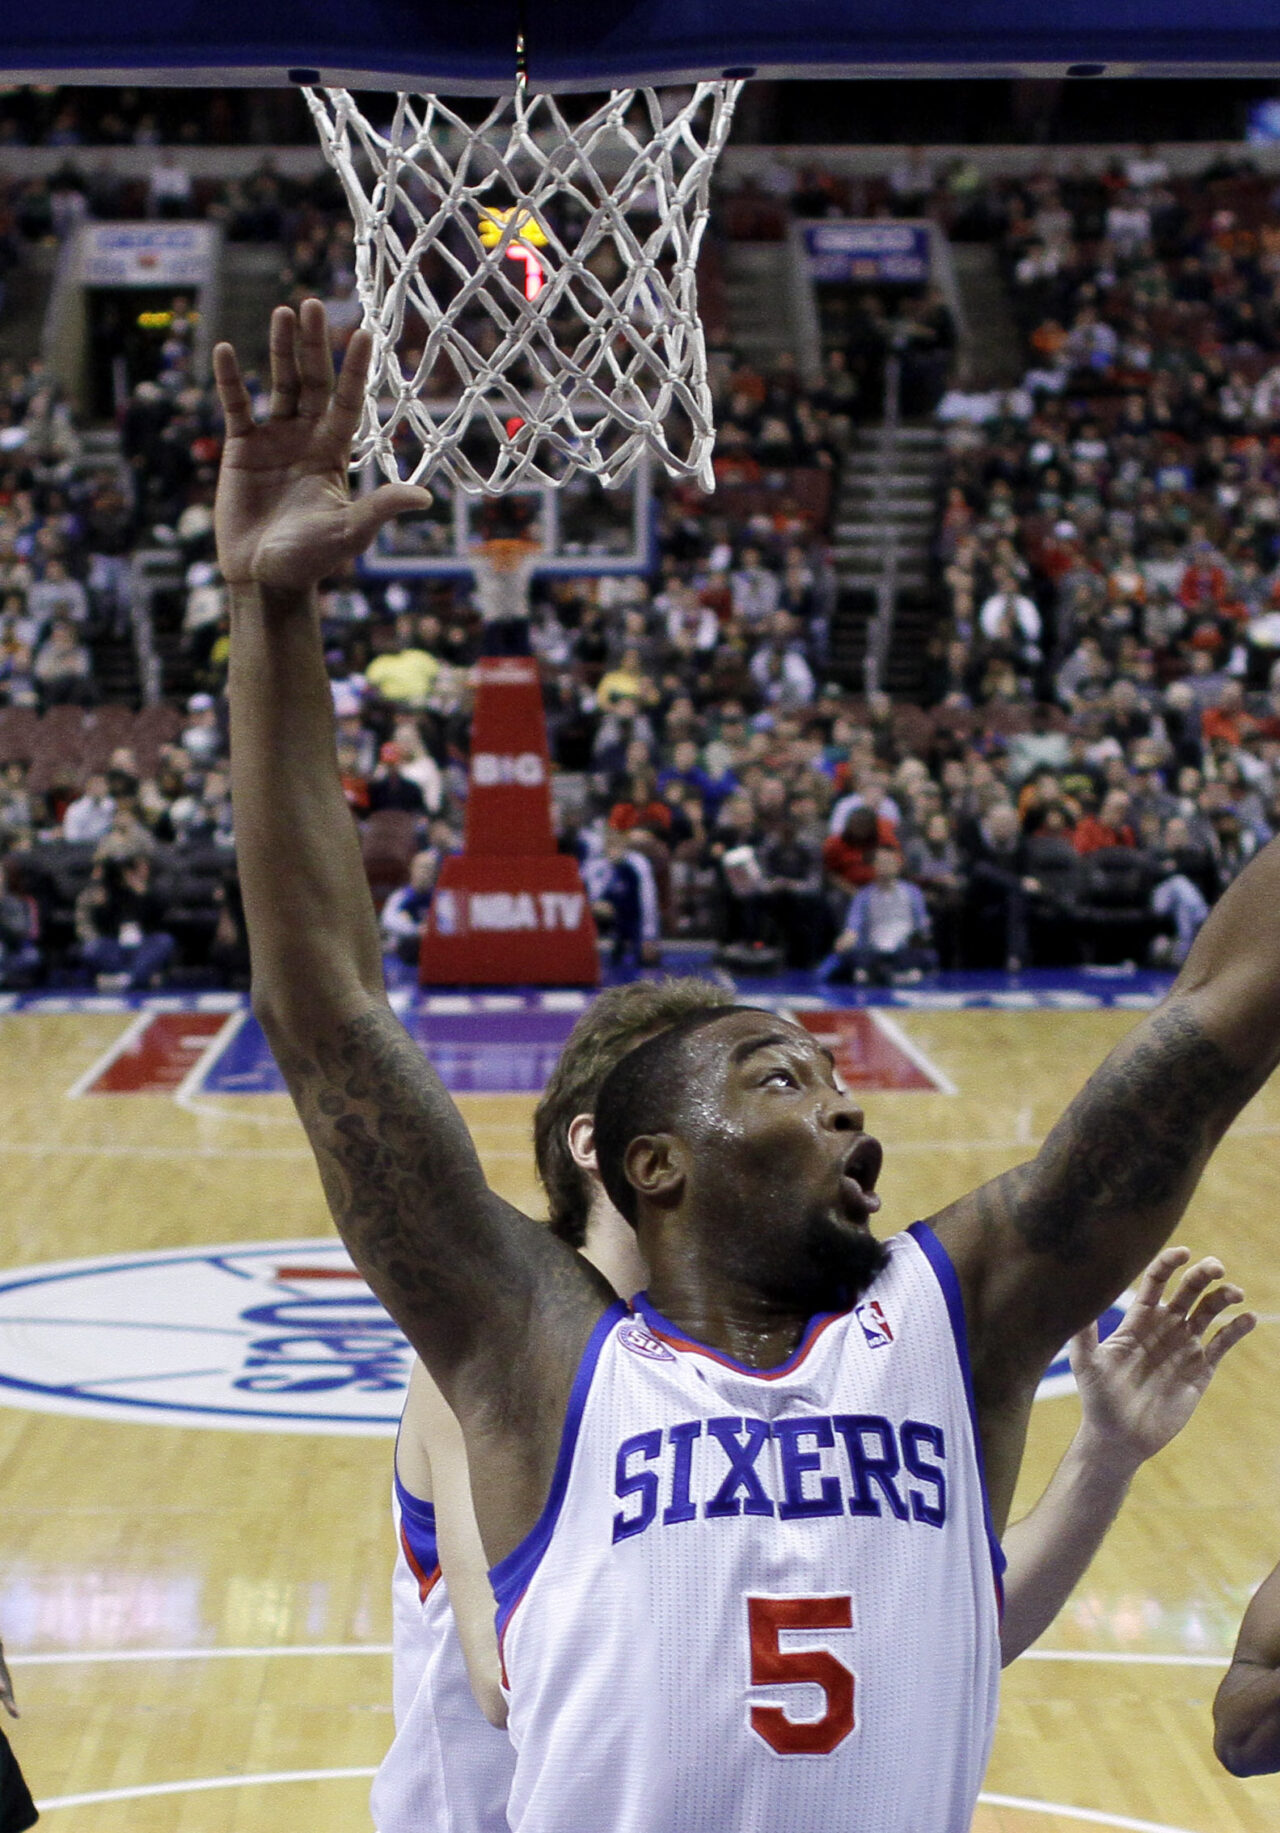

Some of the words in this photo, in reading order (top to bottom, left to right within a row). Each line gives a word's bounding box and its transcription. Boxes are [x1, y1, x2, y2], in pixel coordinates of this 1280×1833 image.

[469, 893, 538, 930] NBA
[540, 892, 584, 930] TV
[612, 1414, 946, 1545] SIXERS
[744, 1591, 857, 1757] 5
